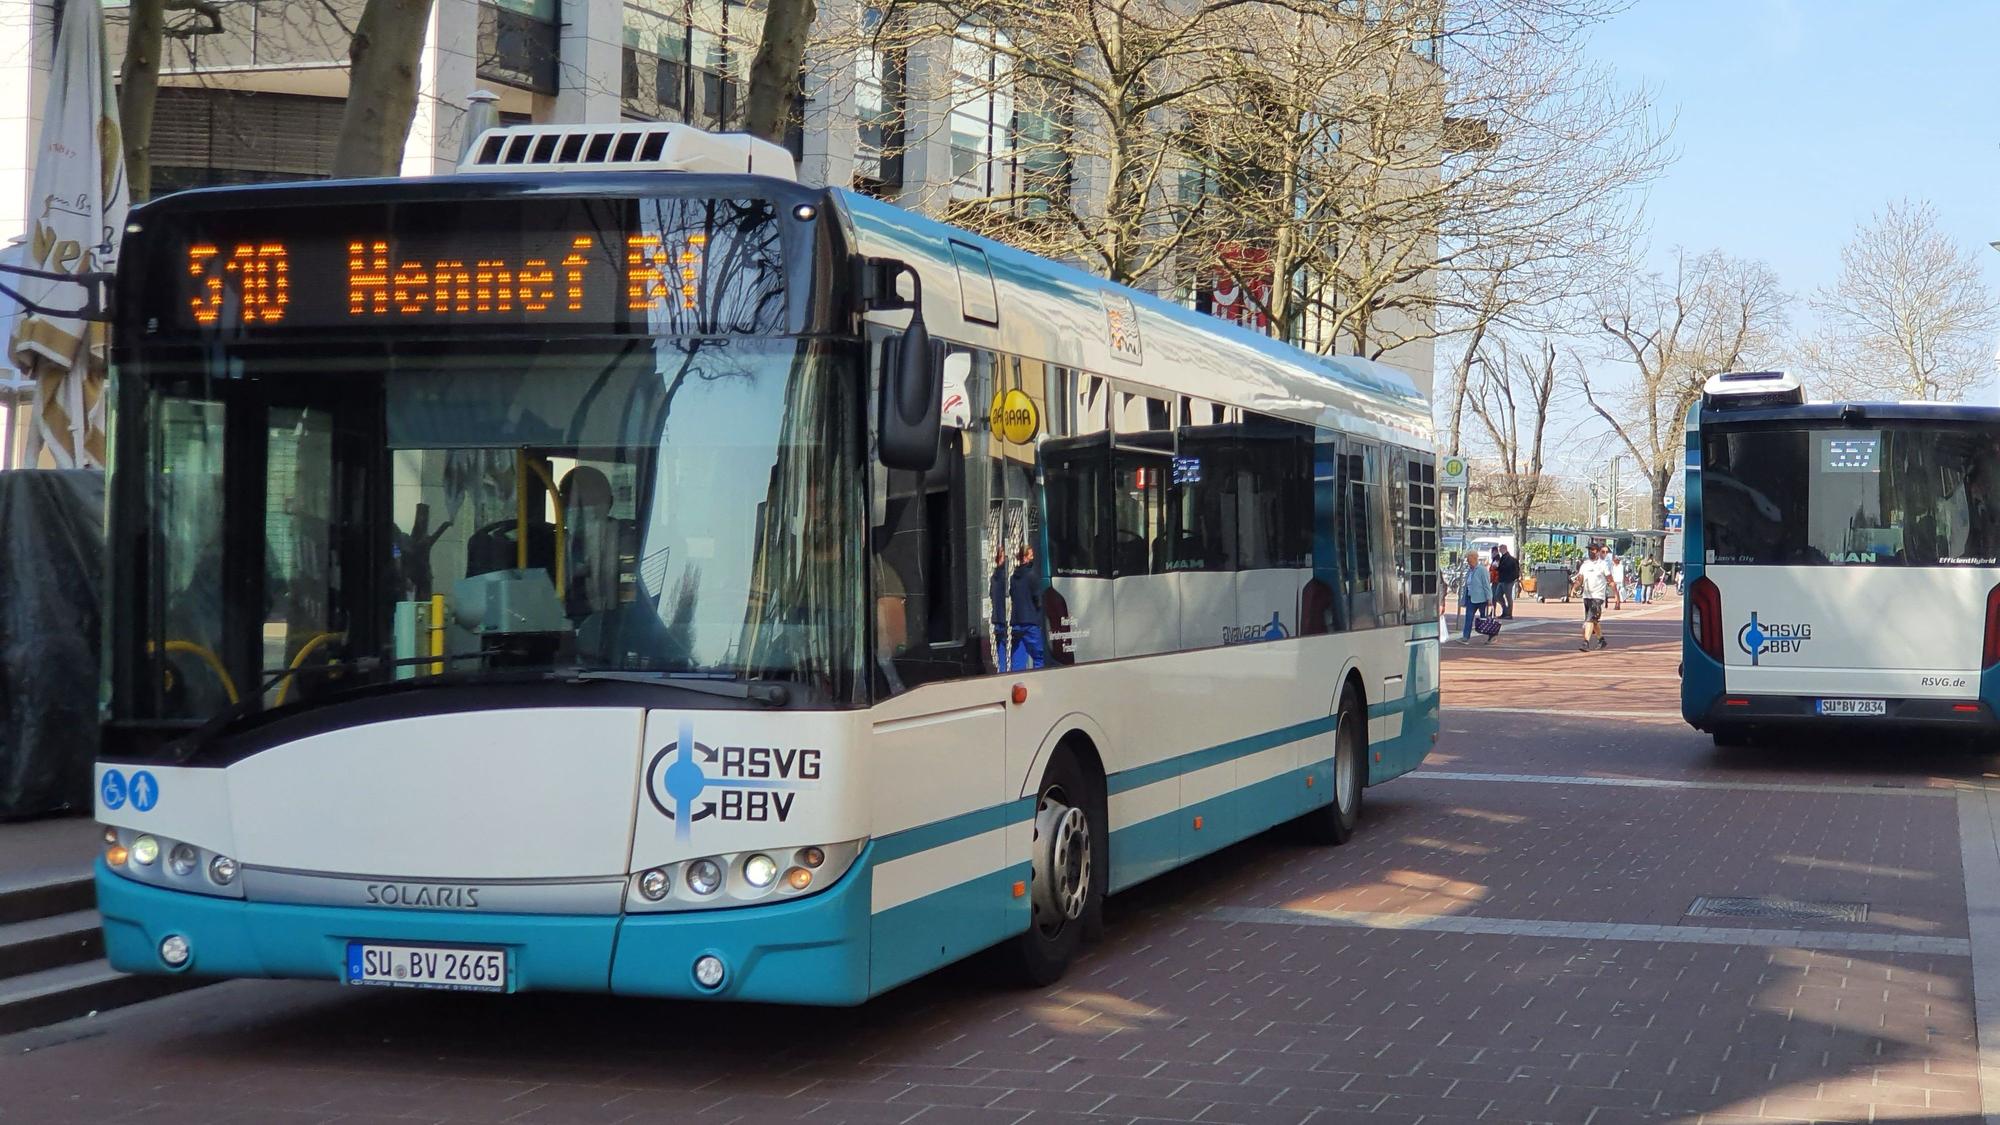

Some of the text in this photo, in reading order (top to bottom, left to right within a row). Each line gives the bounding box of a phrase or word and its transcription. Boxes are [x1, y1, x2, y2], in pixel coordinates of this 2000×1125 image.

[190, 232, 707, 321] 510 Hennef Bf
[1829, 552, 1877, 563] MAN
[1770, 624, 1811, 637] RSVG
[1770, 640, 1801, 653] BBV
[1921, 677, 1966, 688] RSVG.de
[1823, 701, 1884, 713] SU BV 2834
[722, 747, 821, 779] RSVG
[721, 790, 795, 822] BBV
[366, 884, 480, 908] SOLARIS
[365, 950, 391, 976] SU
[410, 952, 437, 979] BV
[444, 954, 500, 981] 2665
